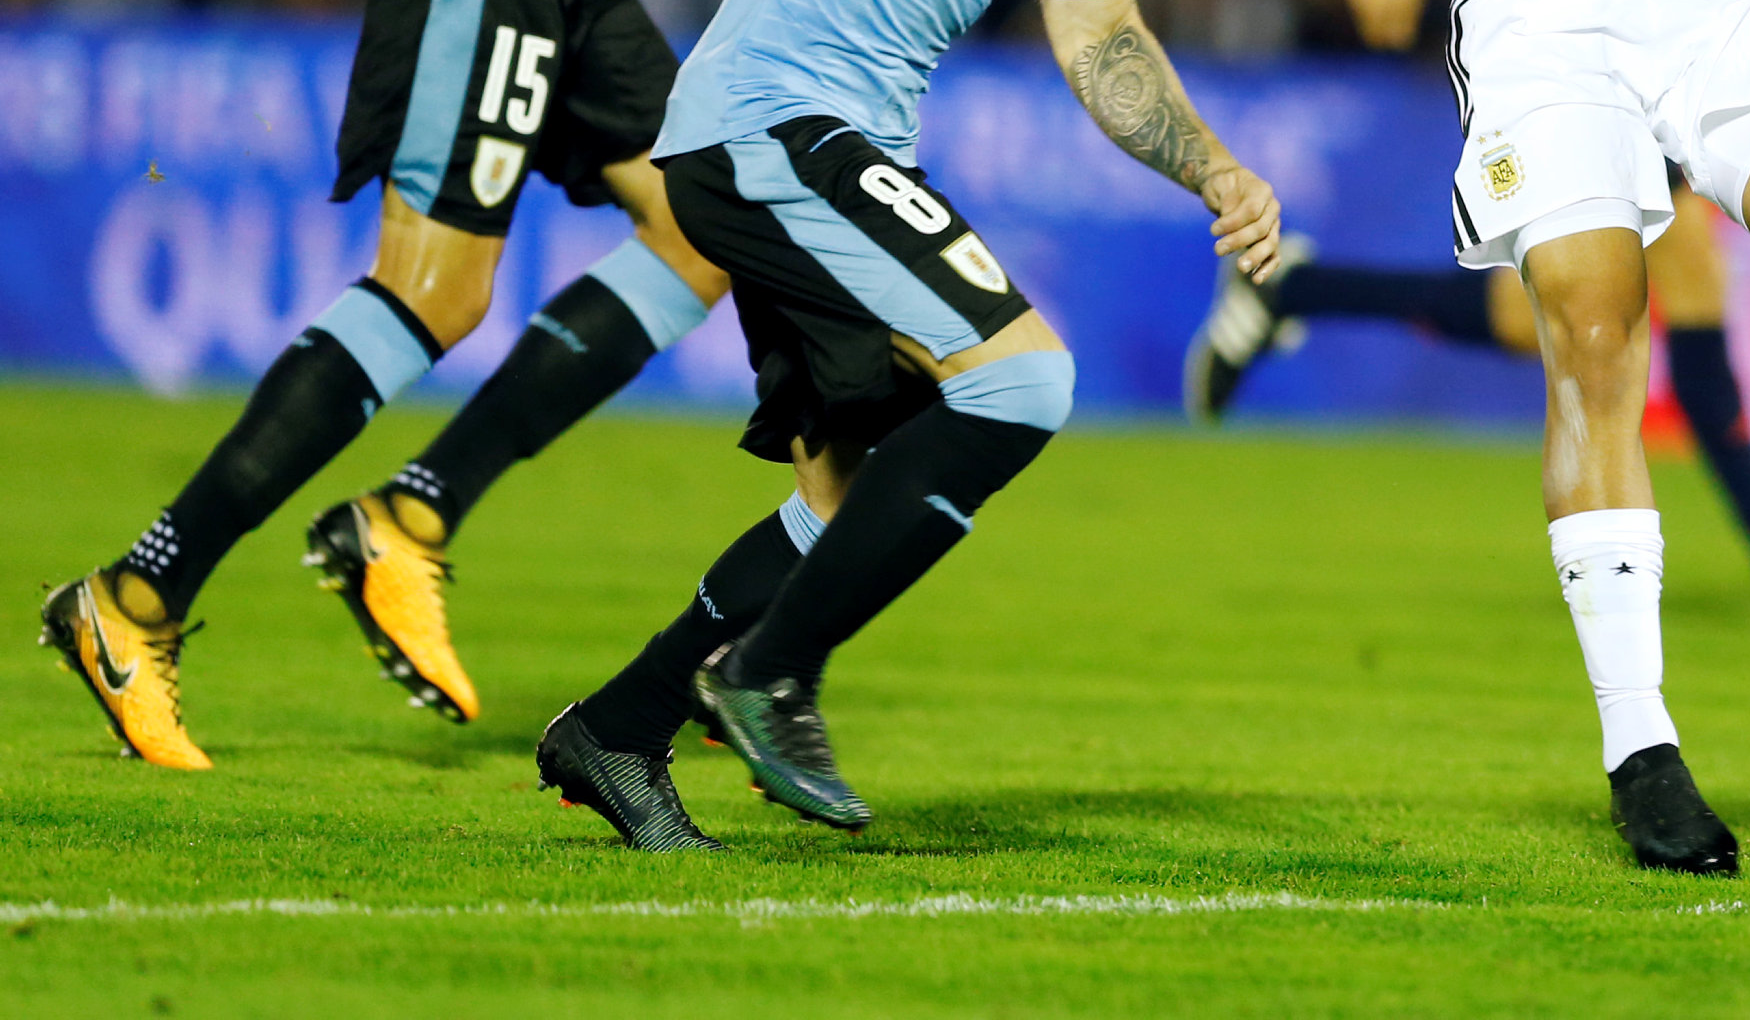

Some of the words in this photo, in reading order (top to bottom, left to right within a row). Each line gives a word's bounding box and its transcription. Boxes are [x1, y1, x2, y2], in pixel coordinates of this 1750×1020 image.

[478, 25, 556, 136] 15
[858, 163, 952, 236] 8
[1492, 159, 1516, 185] AFA
